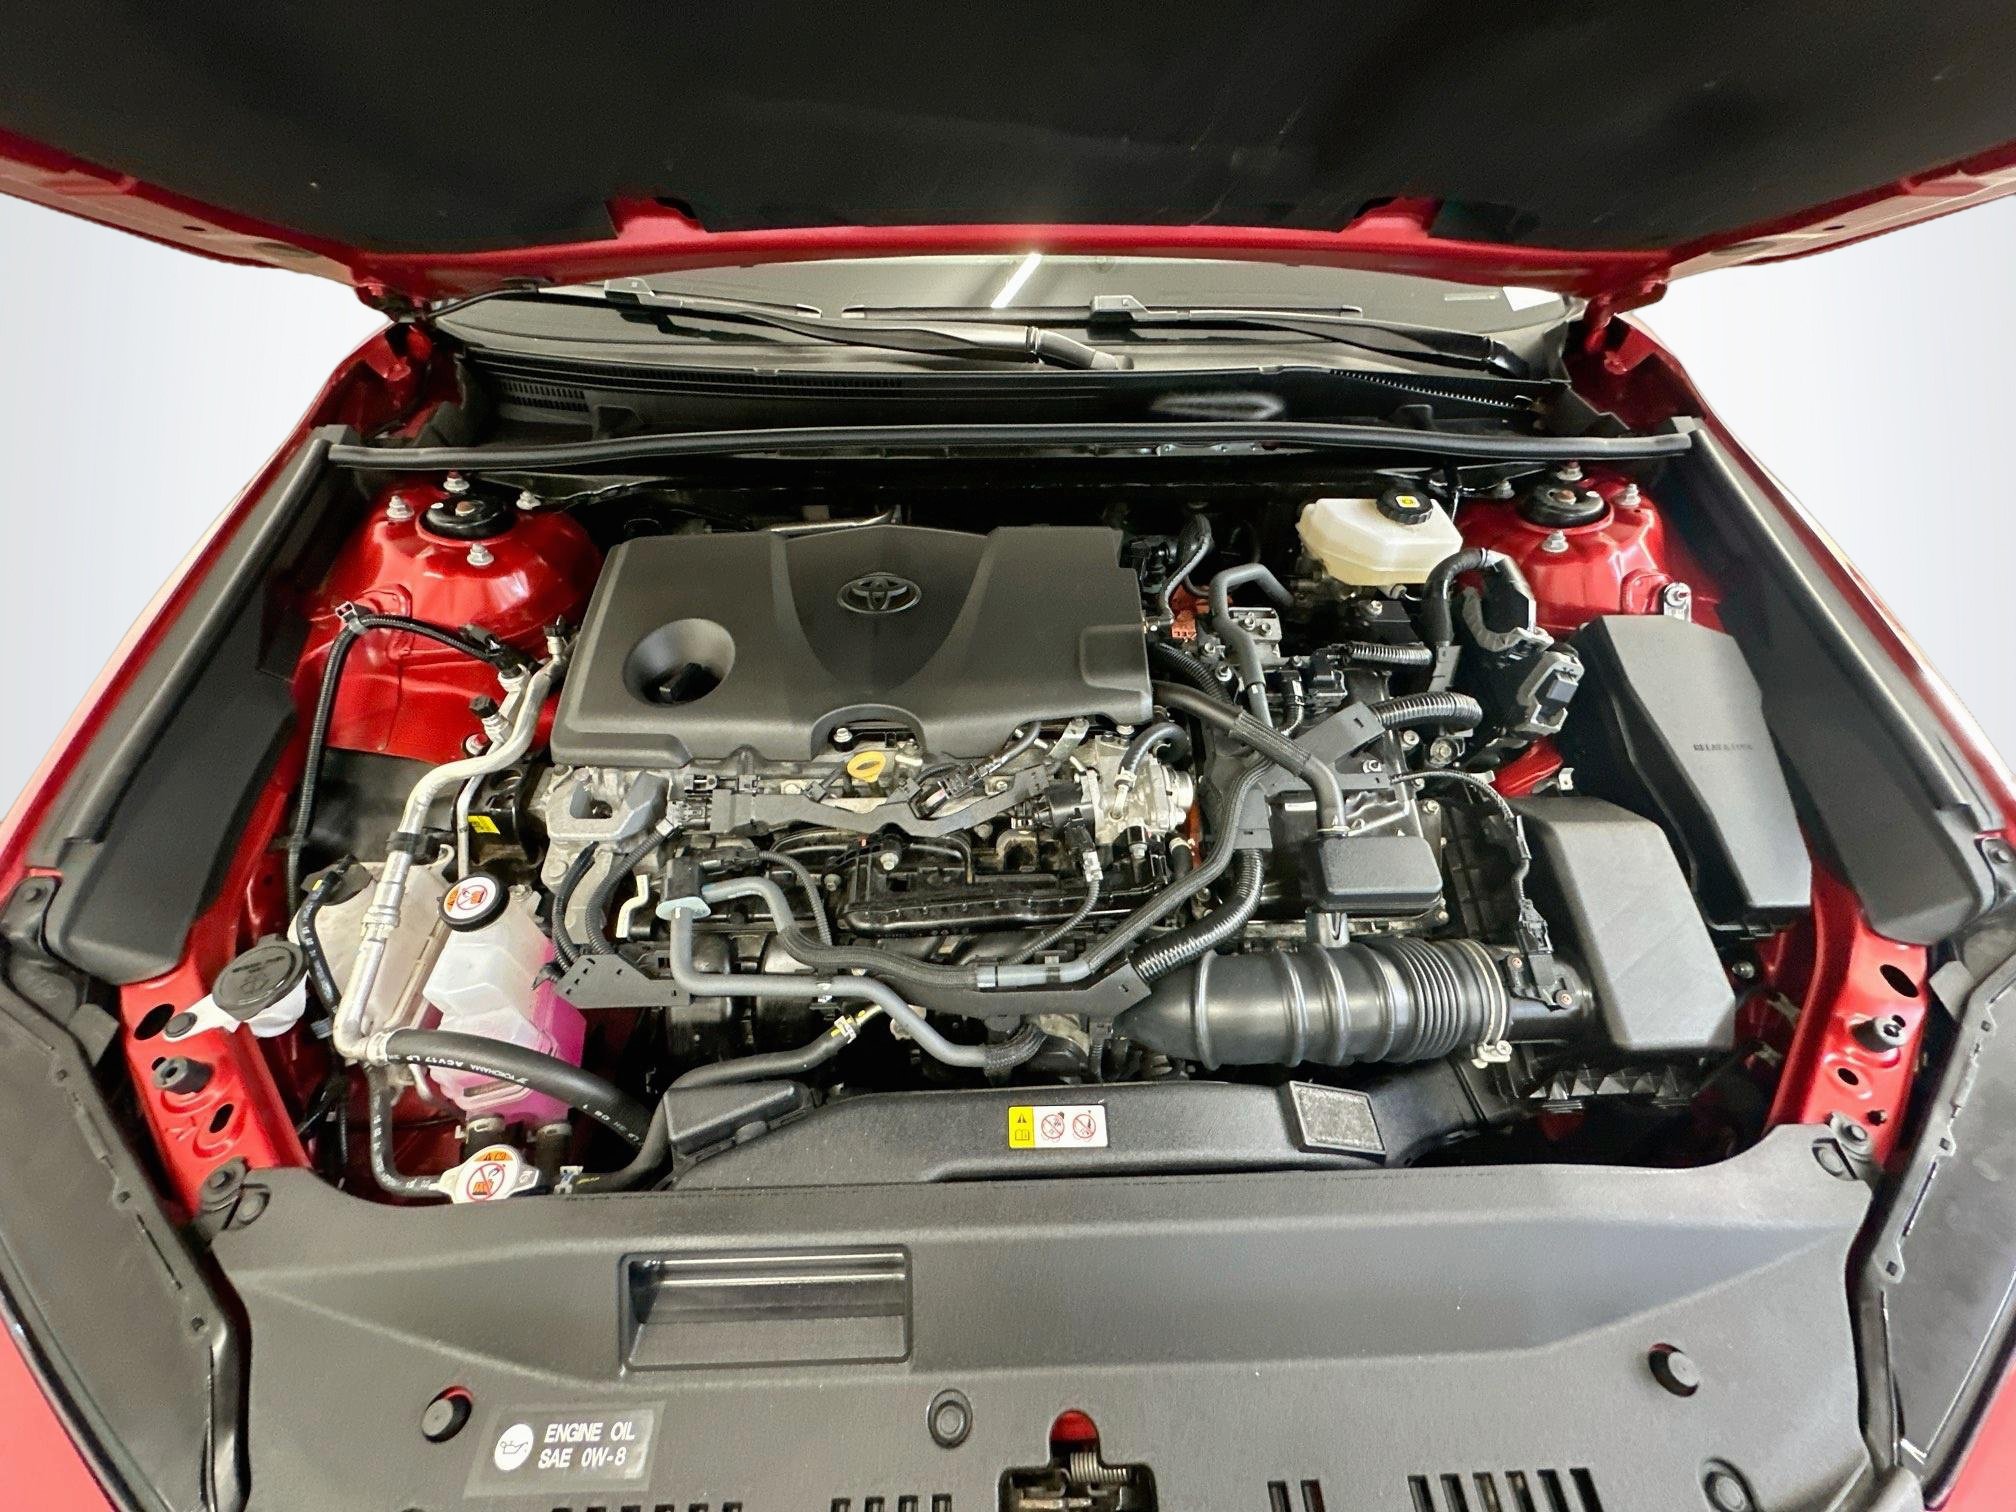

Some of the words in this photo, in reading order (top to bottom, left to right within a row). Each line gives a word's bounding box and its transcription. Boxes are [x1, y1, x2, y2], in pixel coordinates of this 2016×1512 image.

[470, 1063, 515, 1079] YOKOHAMA
[544, 1422, 603, 1444] ENGINE
[610, 1421, 635, 1442] OIL
[538, 1448, 573, 1469] SAE
[580, 1447, 627, 1468] 0W-8
